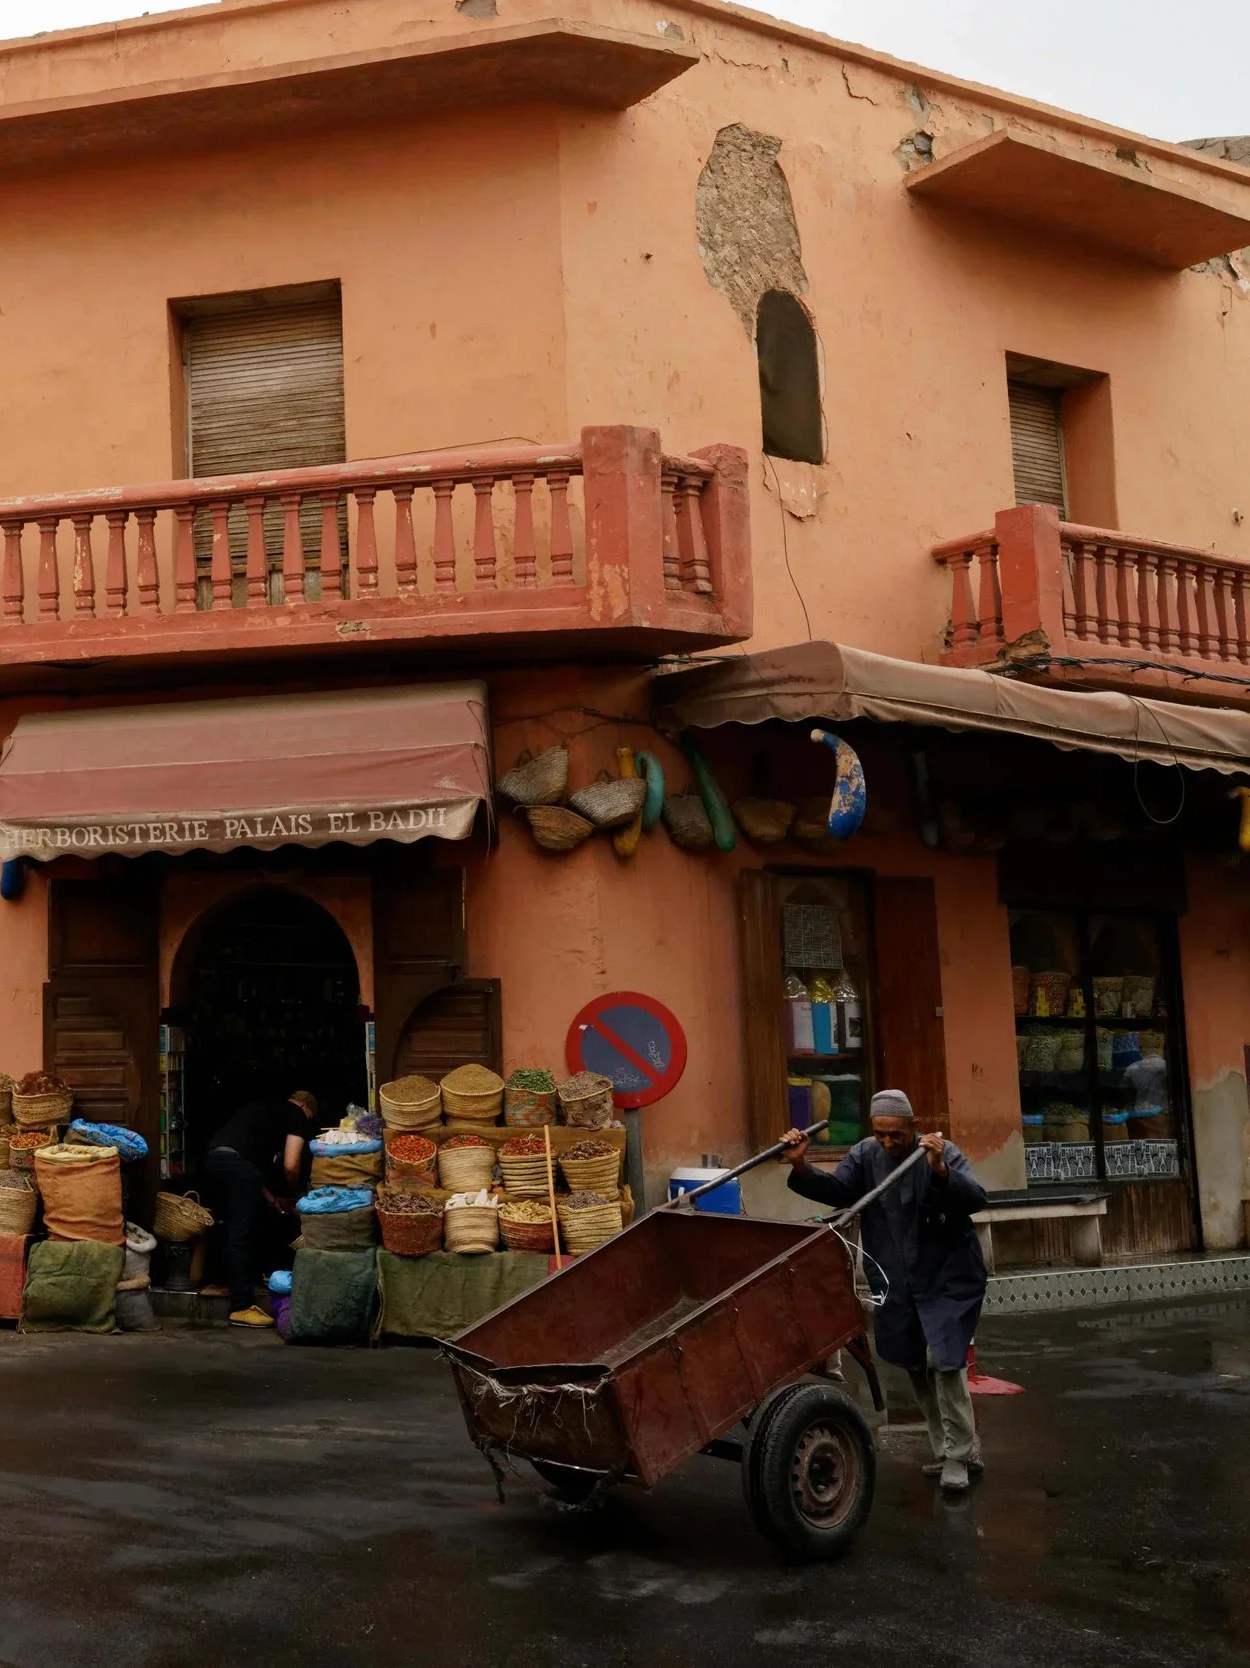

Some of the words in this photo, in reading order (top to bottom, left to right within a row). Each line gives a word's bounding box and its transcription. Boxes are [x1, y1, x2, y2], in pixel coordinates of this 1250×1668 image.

[3, 820, 210, 849] HERBORISTERIE
[224, 813, 313, 839] PALAIS
[328, 812, 360, 833] EL
[367, 807, 447, 831] BADII
